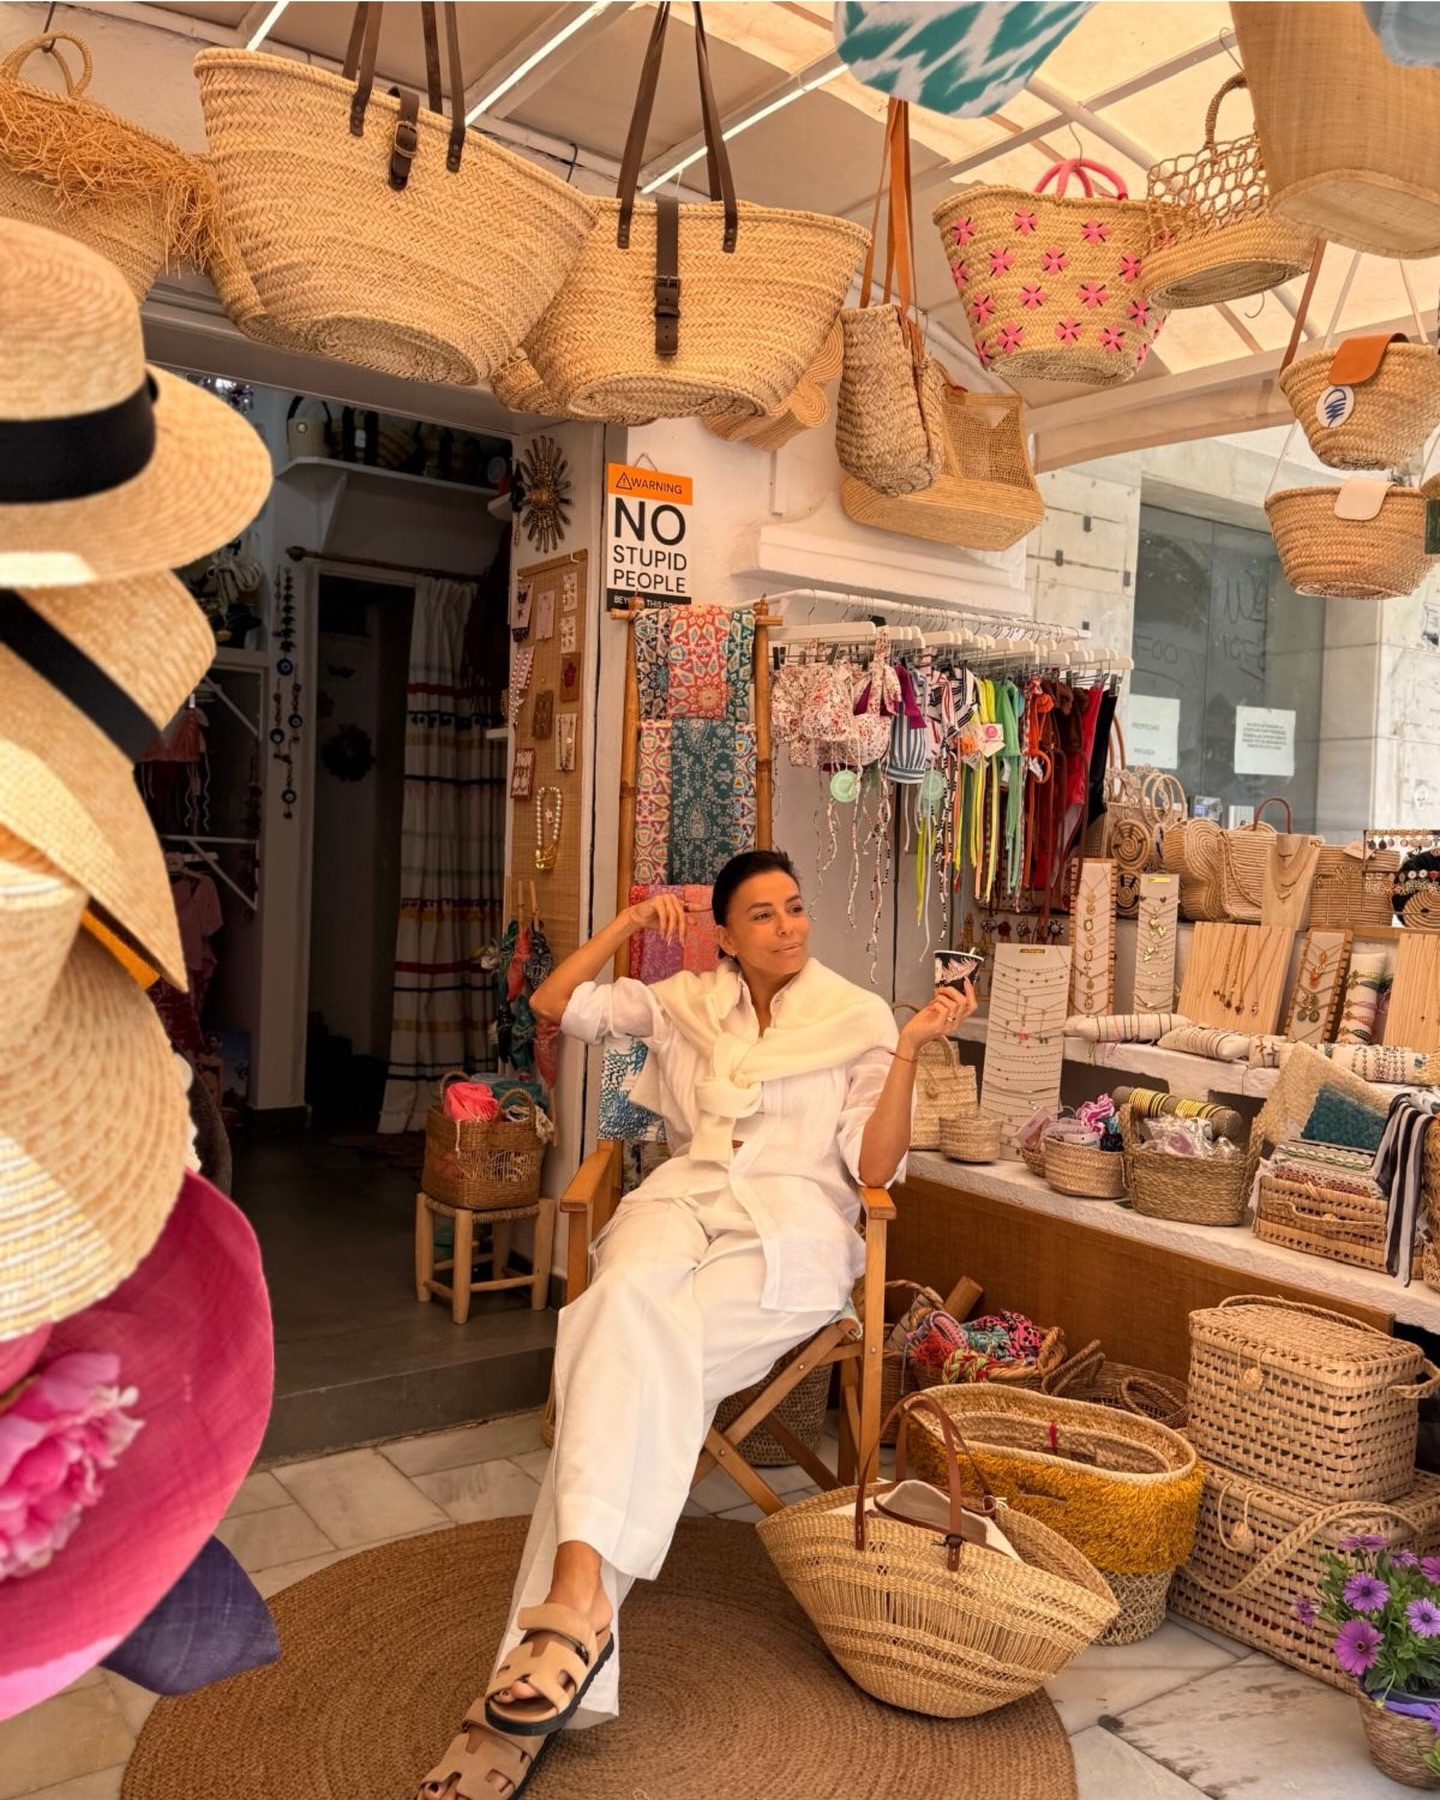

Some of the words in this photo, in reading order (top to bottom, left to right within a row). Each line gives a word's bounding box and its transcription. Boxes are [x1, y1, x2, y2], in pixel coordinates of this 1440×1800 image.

[631, 476, 683, 495] WARNING
[614, 497, 686, 546] NO
[613, 544, 687, 571] STUPID
[613, 568, 686, 593] PEOPLE
